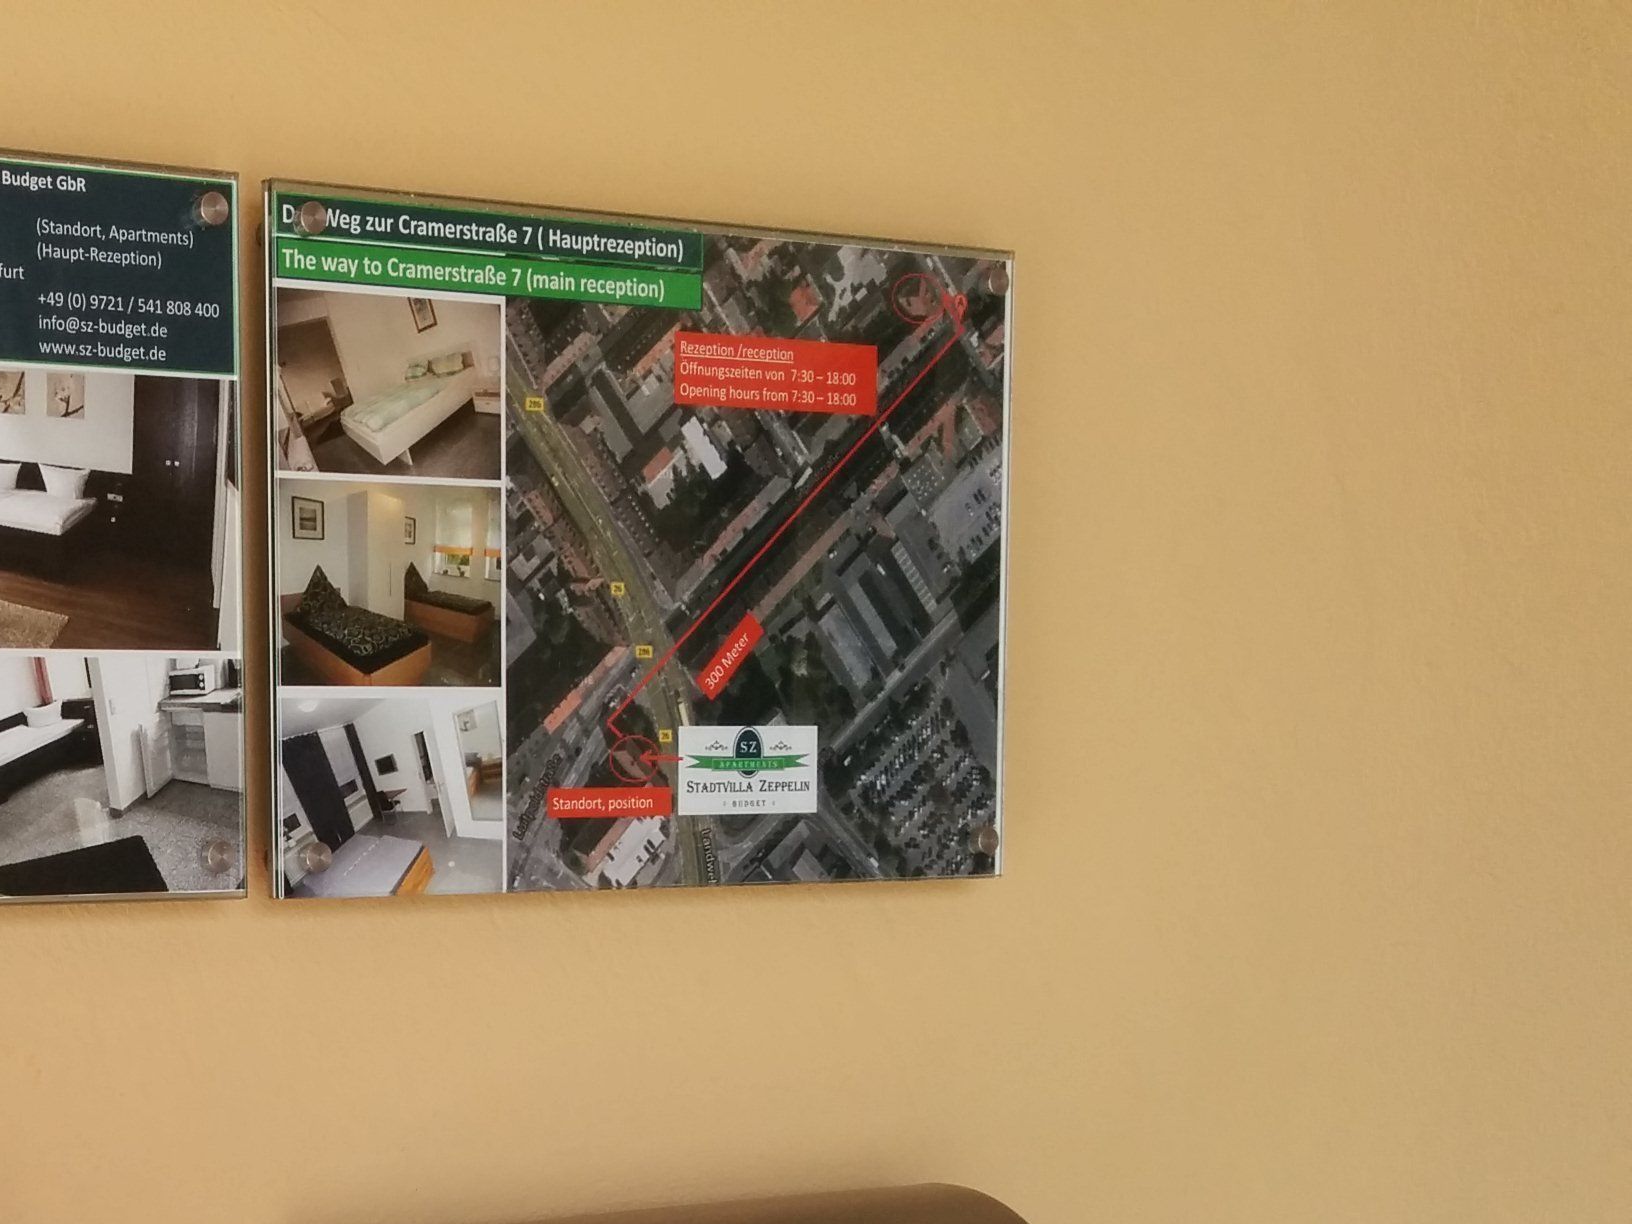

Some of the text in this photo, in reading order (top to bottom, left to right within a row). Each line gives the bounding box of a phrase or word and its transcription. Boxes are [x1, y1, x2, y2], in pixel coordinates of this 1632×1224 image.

[0, 169, 54, 192] Budget
[55, 174, 86, 193] GbR
[36, 217, 195, 250] (Standort, Apartments)
[364, 216, 395, 234] zur
[397, 214, 518, 244] Cramerstraße
[521, 225, 533, 245] 7
[547, 227, 684, 263] Hauptrezeption)
[37, 242, 163, 271] (Haupt-Rezeption)
[282, 248, 665, 302] The way to Cramerstraße 7 (main reception)
[38, 291, 65, 308] +49
[66, 291, 87, 313] (0)
[88, 294, 125, 312] 9721
[136, 297, 163, 314] 541
[165, 299, 192, 316] 808
[193, 301, 220, 318] 400
[38, 314, 168, 340] info@sz-budget.de
[39, 341, 167, 363] www.sz-budget.de
[680, 341, 794, 363] Rezeption /reception
[679, 358, 763, 381] Öffnungszeiten
[763, 369, 786, 381] von
[790, 368, 815, 383] 7:30
[825, 370, 857, 385] 18:00
[679, 382, 727, 402] Opening
[727, 385, 761, 400] hours
[761, 387, 790, 402] from
[791, 389, 816, 404] 7:30
[826, 391, 857, 406] 18:00
[704, 632, 750, 691] 300 Meter
[739, 741, 757, 753] SZ
[686, 780, 810, 793] STADTVILLA ZEPPELIN
[553, 796, 654, 813] Standort, position
